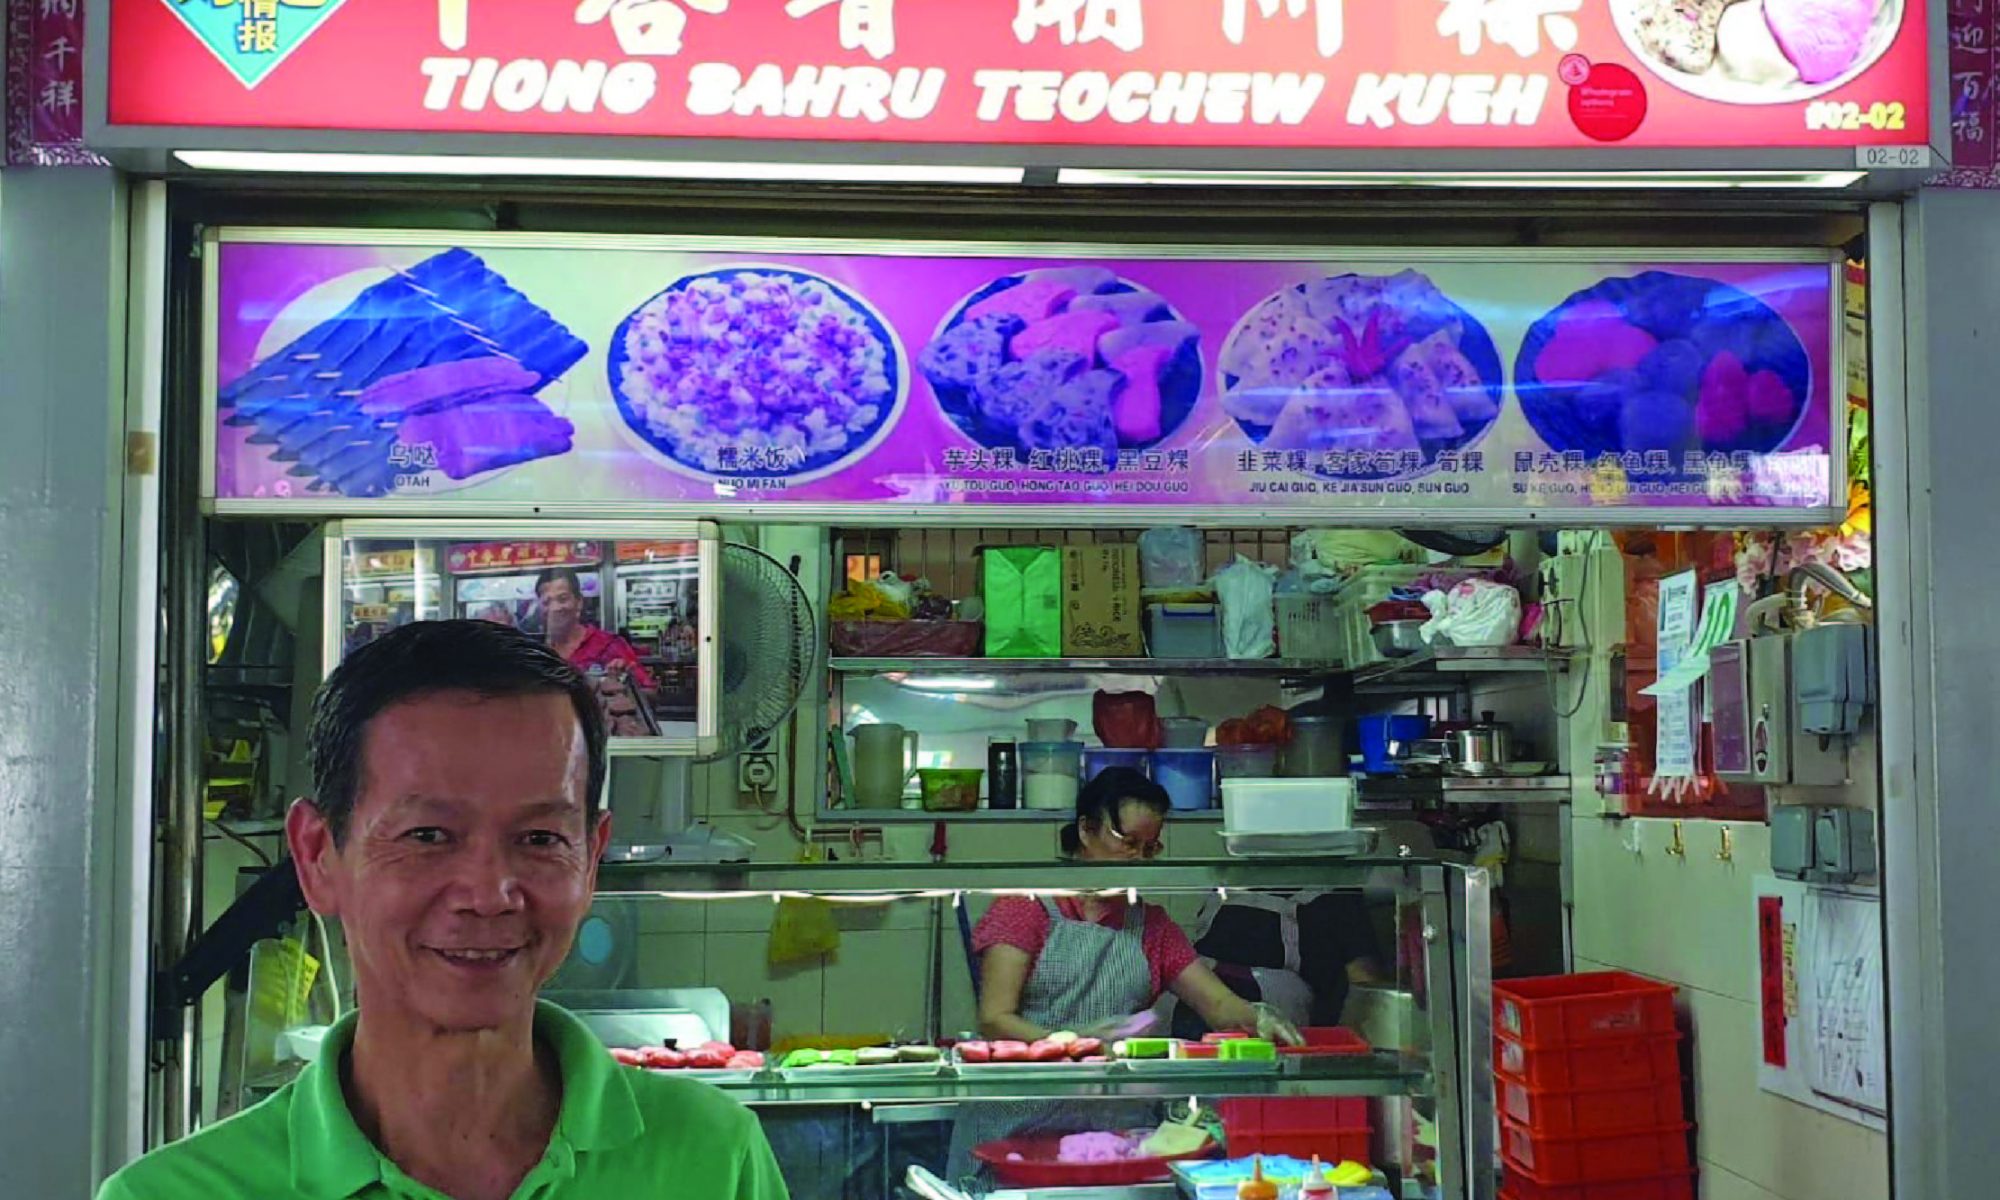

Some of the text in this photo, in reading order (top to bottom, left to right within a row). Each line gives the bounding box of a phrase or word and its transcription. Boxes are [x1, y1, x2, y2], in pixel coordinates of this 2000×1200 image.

[420, 58, 1548, 129] TIONG BAHRU TEOCHEW KUEH
[1866, 148, 1920, 165] 02-02
[395, 476, 430, 487] OTAH
[747, 479, 760, 489] MI
[762, 479, 787, 489] FAN
[1022, 481, 1054, 492] HONG
[1059, 481, 1080, 492] TAO
[1136, 481, 1161, 492] DOU
[1164, 481, 1189, 492] GUO
[1249, 482, 1267, 493] JIU
[1269, 482, 1289, 493] CAI
[1323, 482, 1338, 493] KE
[1340, 482, 1358, 493] JIA
[1360, 482, 1384, 493] SUN
[1418, 482, 1442, 493] SUN
[1444, 482, 1470, 494] GUO
